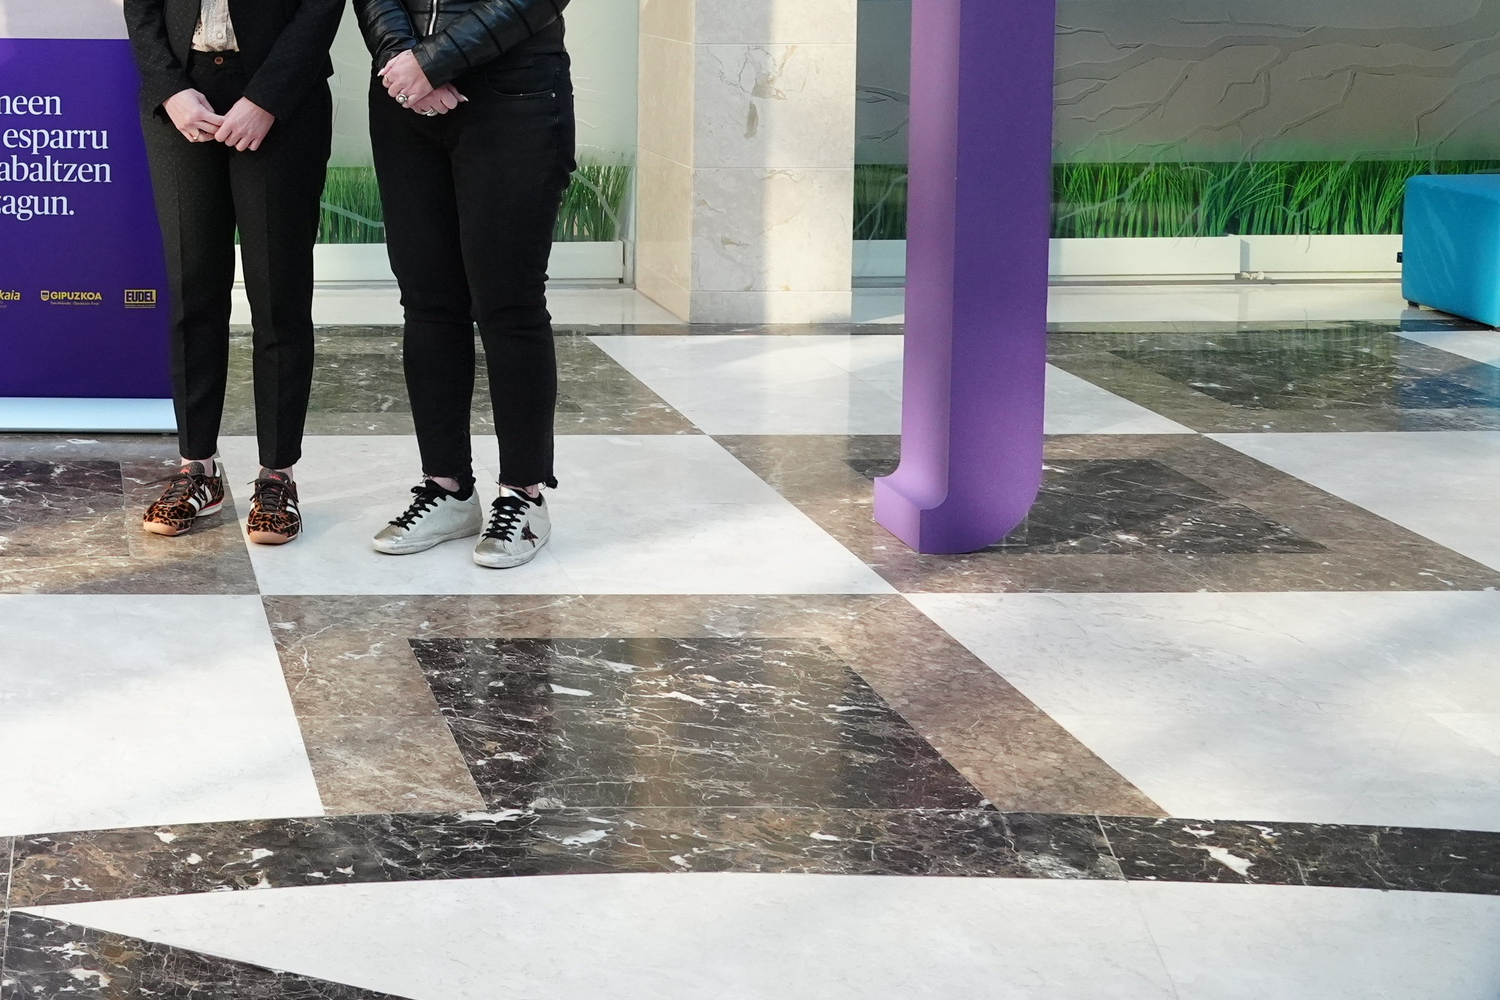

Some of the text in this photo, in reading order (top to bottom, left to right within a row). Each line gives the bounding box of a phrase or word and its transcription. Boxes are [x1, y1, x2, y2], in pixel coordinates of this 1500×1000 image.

[2, 129, 109, 155] esparru
[50, 291, 102, 301] GIPUZKOA
[126, 290, 155, 303] EUDEL
